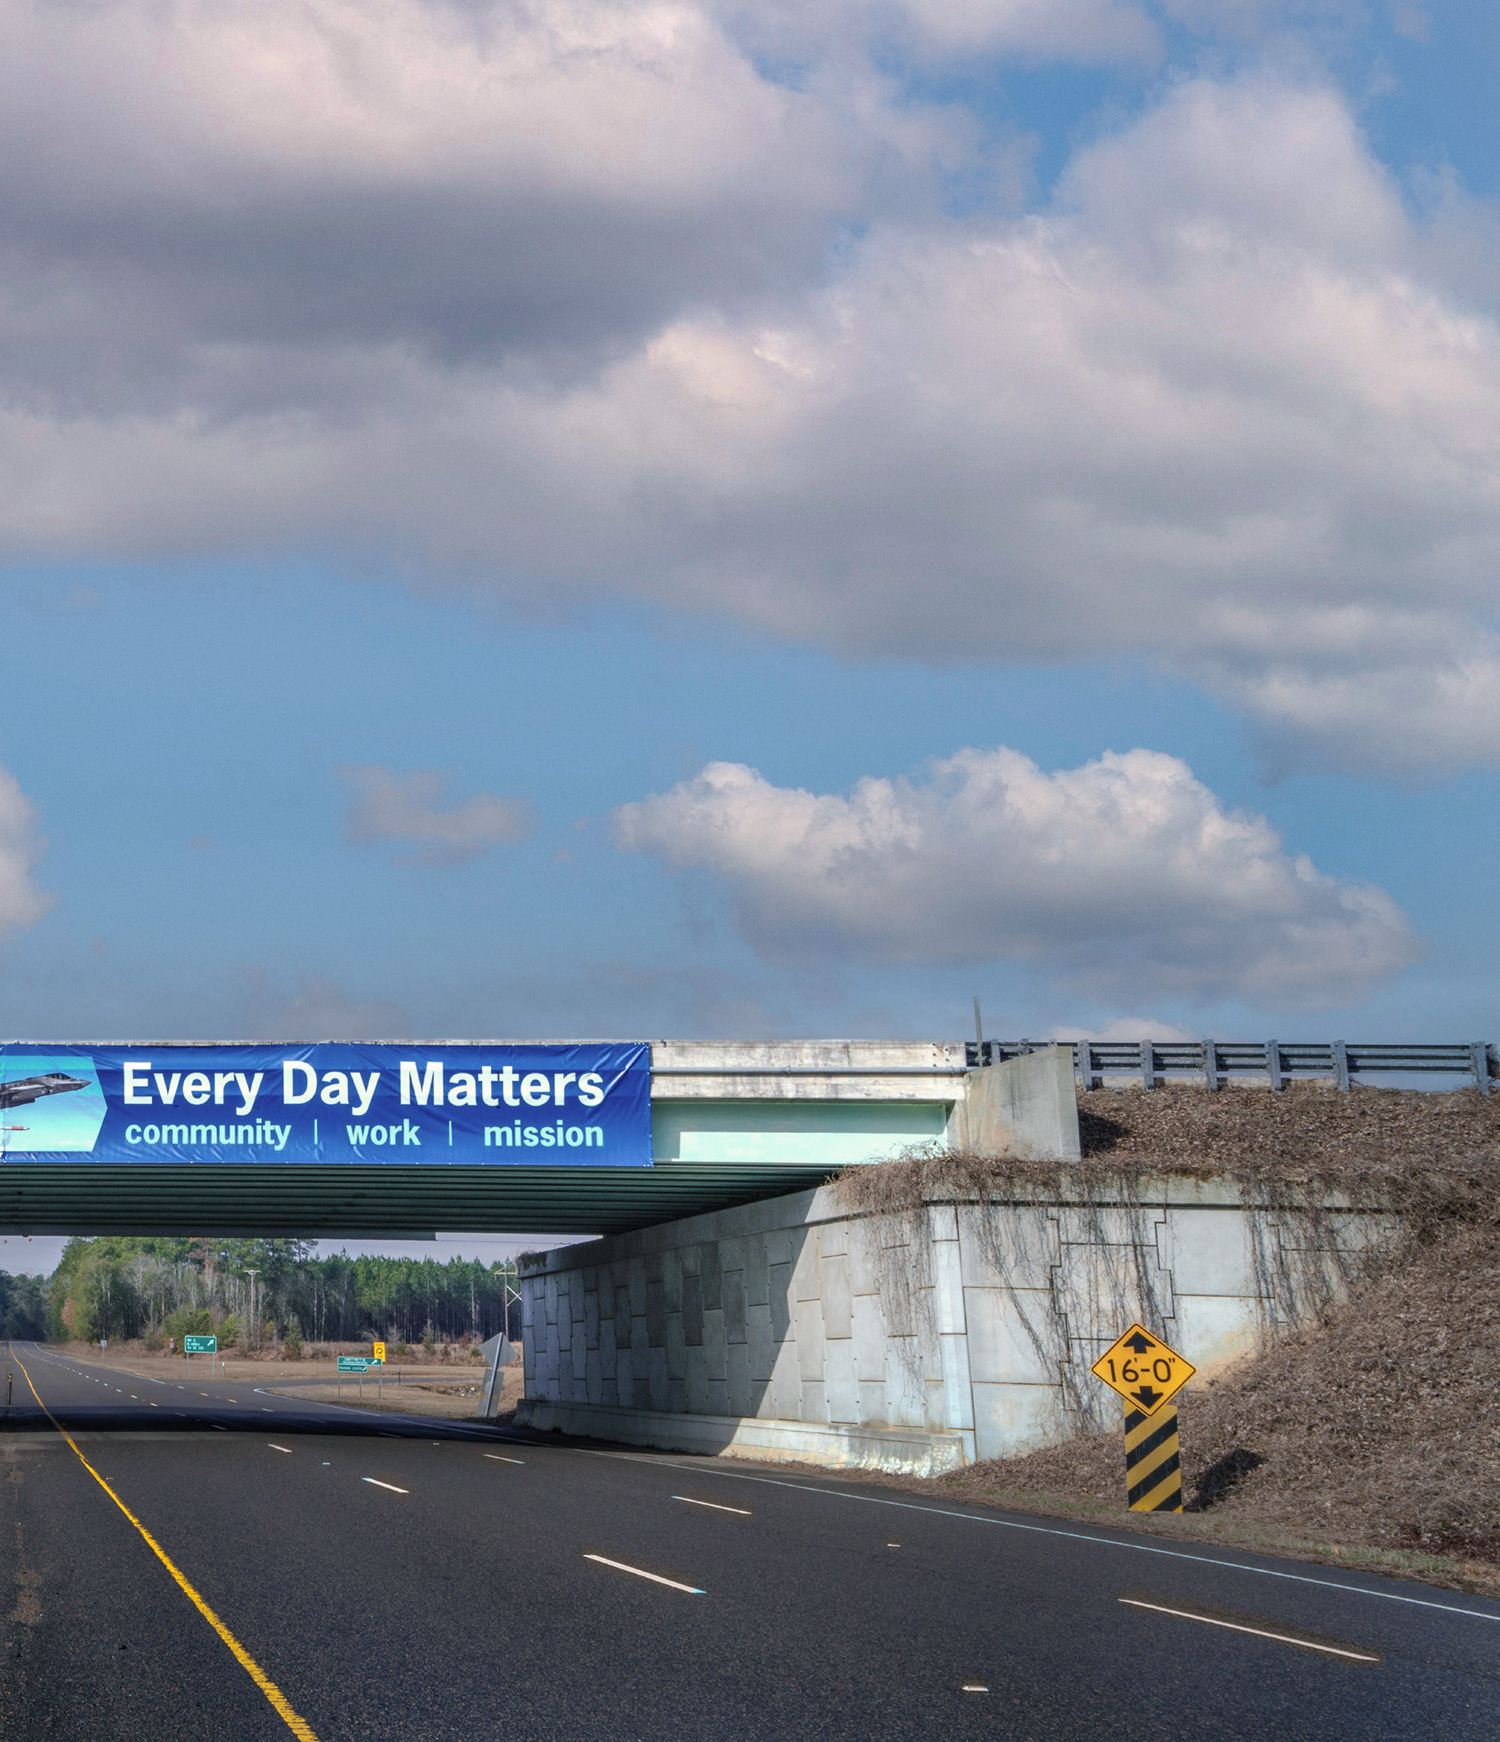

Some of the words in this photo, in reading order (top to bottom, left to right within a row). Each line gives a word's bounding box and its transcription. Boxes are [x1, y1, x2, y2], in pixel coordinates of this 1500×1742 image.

[122, 1062, 264, 1116] Every
[282, 1061, 381, 1116] Day
[398, 1061, 605, 1107] Matters
[124, 1117, 292, 1151] community
[345, 1118, 422, 1147] work
[483, 1118, 605, 1147] mission
[1106, 1357, 1176, 1384] 16'-0"
